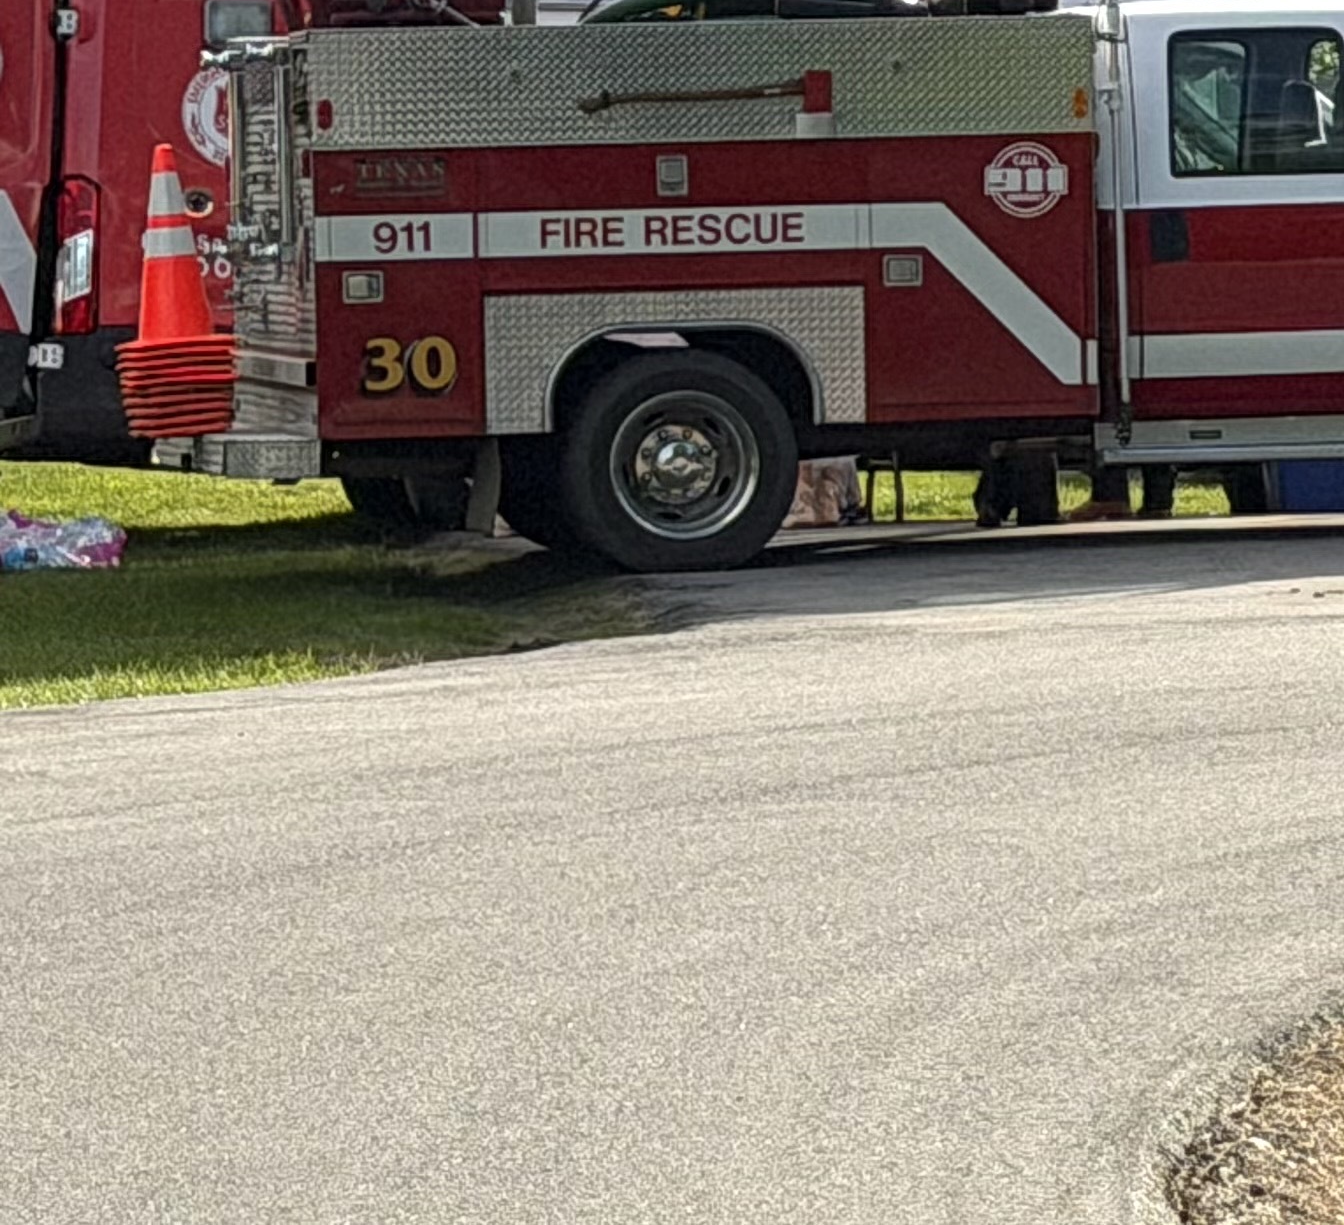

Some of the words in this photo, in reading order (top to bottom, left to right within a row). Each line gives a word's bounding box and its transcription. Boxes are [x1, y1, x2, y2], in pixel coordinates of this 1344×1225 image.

[986, 166, 1065, 193] 911
[372, 220, 432, 255] 911
[540, 216, 625, 250] FIRE
[643, 212, 805, 246] RESCUE
[362, 335, 458, 394] 30
